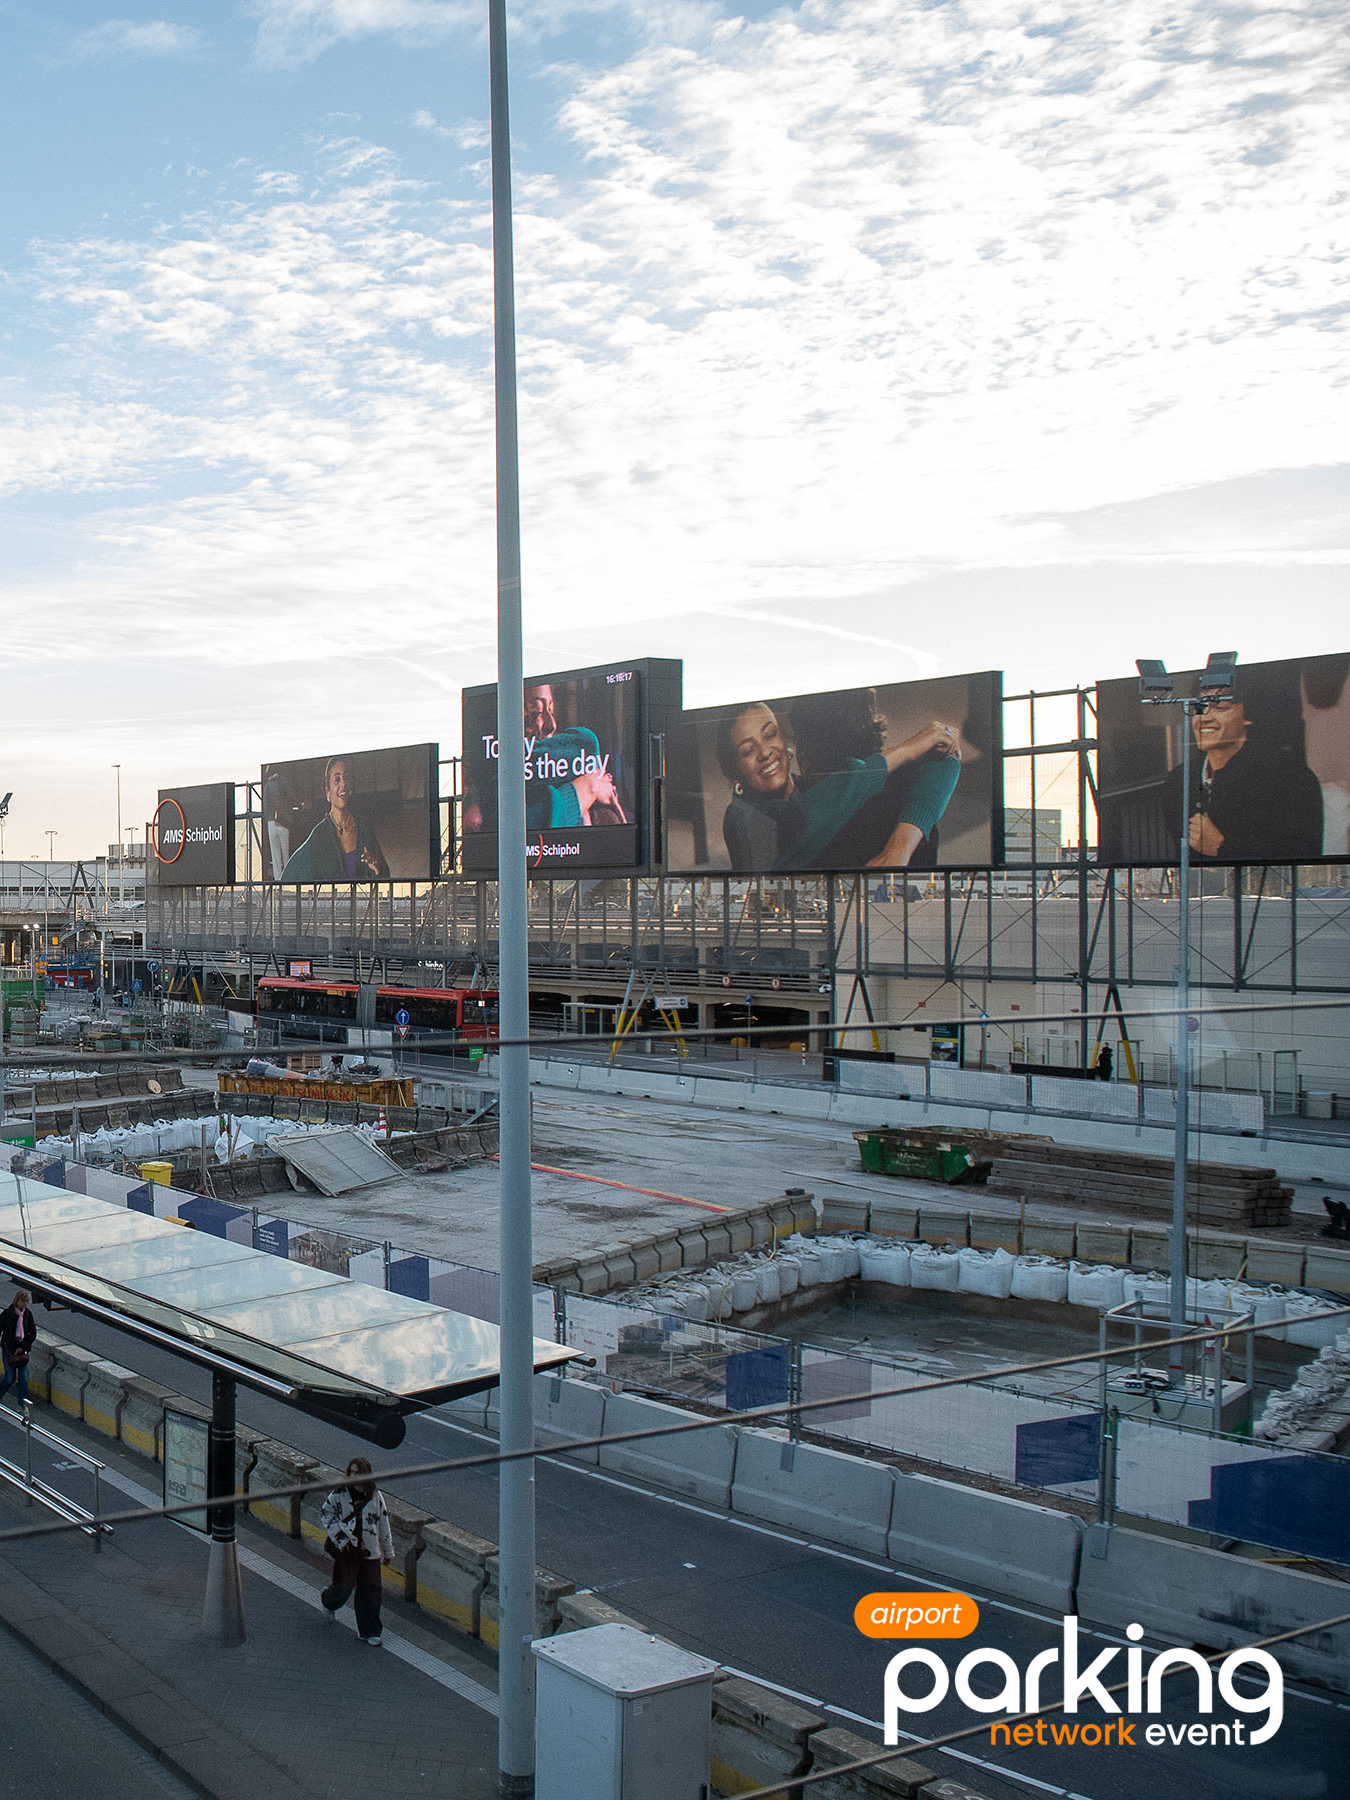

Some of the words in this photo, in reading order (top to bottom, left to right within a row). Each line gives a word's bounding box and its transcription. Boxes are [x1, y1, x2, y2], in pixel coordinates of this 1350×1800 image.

[482, 735, 536, 761] Toy
[536, 752, 568, 779] the
[572, 749, 610, 780] day
[163, 829, 183, 844] AMS
[185, 825, 223, 844] Schiphol
[525, 844, 540, 857] MS
[542, 842, 580, 858] Schiphol
